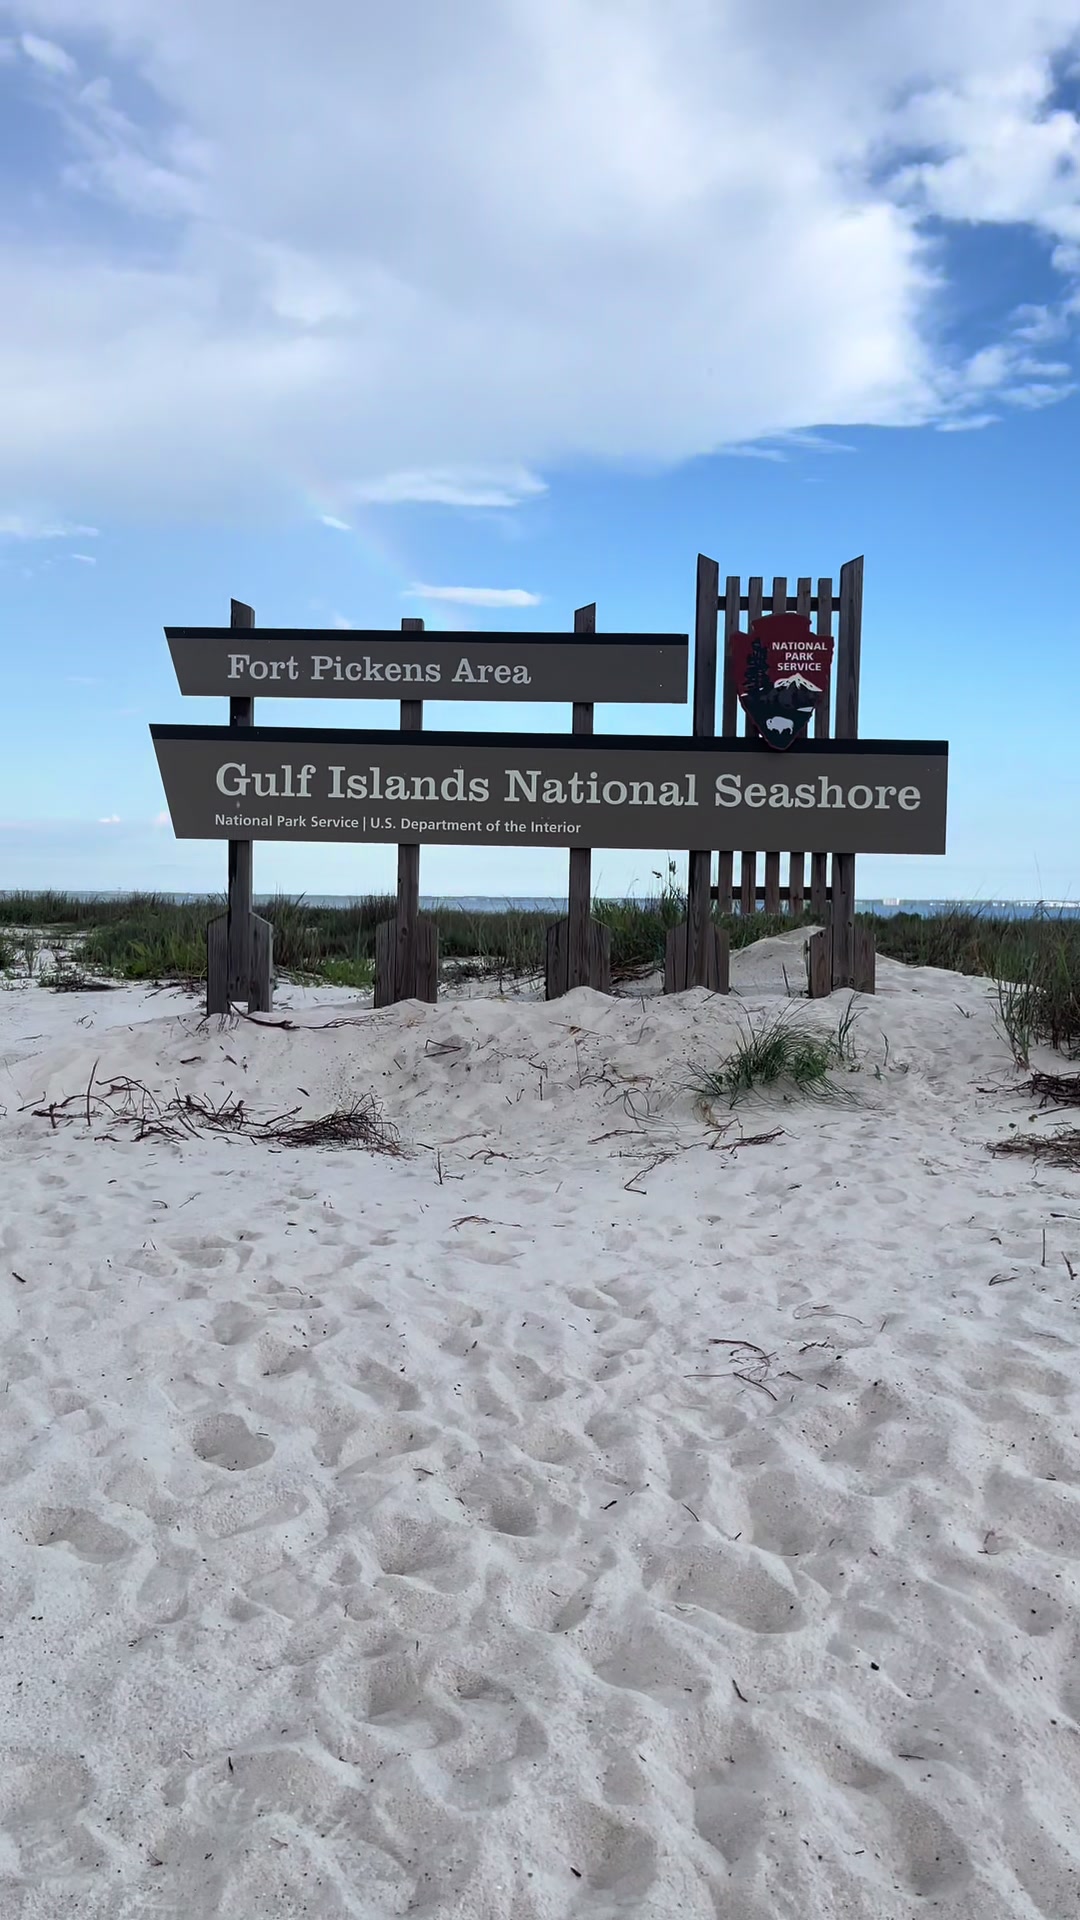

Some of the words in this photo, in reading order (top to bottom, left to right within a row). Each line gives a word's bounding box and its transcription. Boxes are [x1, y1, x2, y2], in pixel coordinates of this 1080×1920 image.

[772, 642, 827, 650] NATIONAL
[785, 652, 814, 660] PARK
[227, 654, 299, 680] Fort
[311, 655, 441, 683] Pickens
[452, 658, 532, 684] Area
[777, 662, 822, 671] SERVICE
[216, 762, 317, 798] Gulf
[327, 766, 490, 802] Islands
[503, 769, 699, 806] National
[715, 773, 921, 811] Seashore
[215, 814, 273, 827] National
[277, 815, 307, 827] Park
[311, 816, 359, 828] Service
[370, 817, 396, 829] U.S.
[401, 818, 482, 833] Department
[486, 819, 501, 832] of
[504, 820, 527, 833] the
[531, 821, 581, 833] Interior
